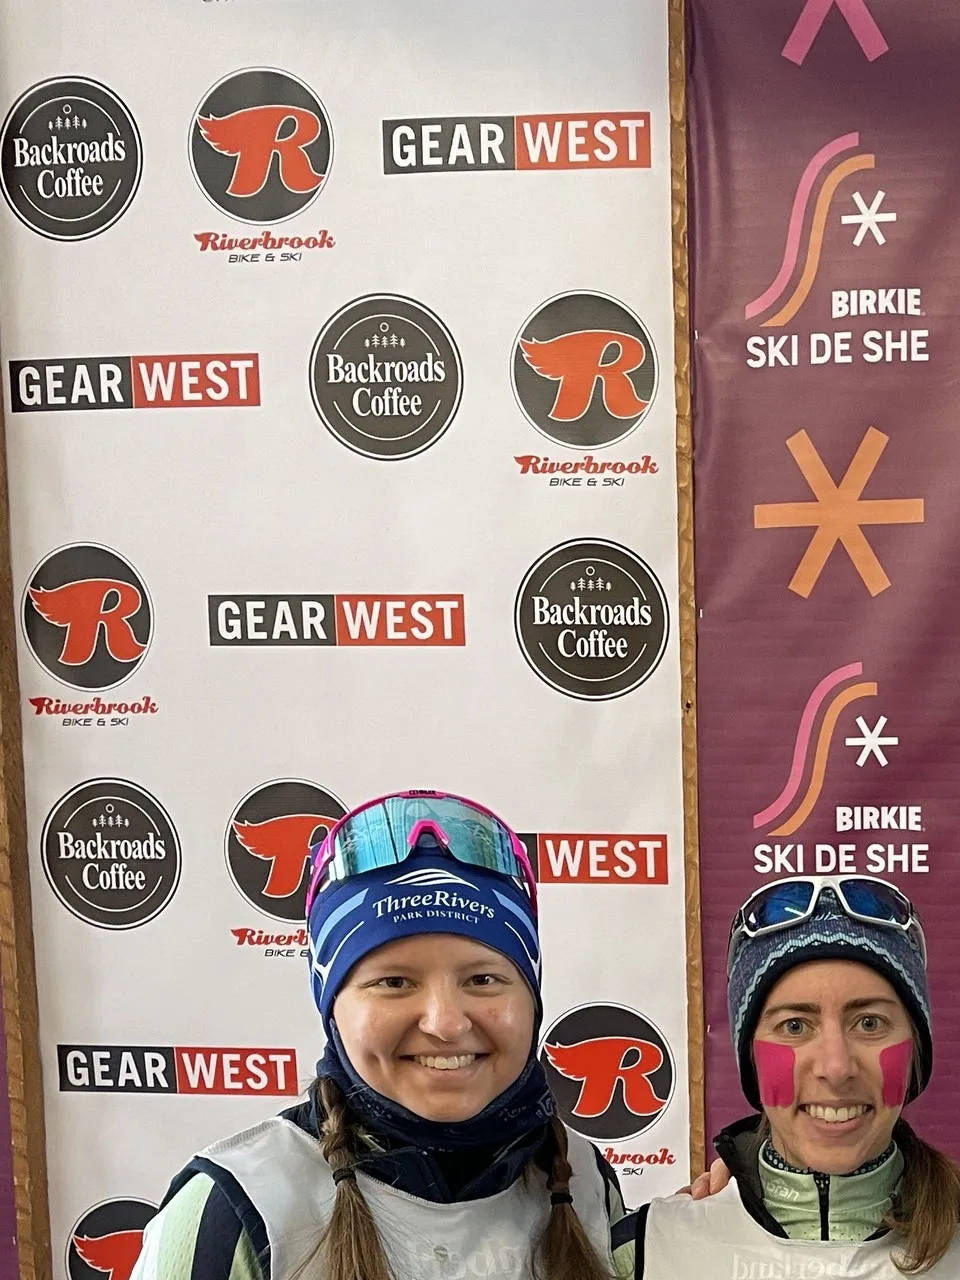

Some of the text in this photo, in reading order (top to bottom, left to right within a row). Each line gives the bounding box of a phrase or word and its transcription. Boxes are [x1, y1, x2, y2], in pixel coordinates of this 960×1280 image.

[13, 133, 127, 168] Backroads
[392, 118, 645, 167] GEAR WEST
[37, 167, 103, 199] Coffee
[194, 230, 336, 251] Riverbrook
[228, 252, 303, 263] BIKE & SKI
[832, 288, 921, 319] BIRKIE
[745, 330, 929, 368] SKI DE SHE
[18, 358, 256, 406] GEAR WEST
[326, 353, 446, 384] Backroads
[352, 387, 422, 418] Coffee
[514, 454, 659, 474] Riverbrook
[549, 477, 625, 487] BIKE & SKI
[217, 601, 459, 640] GEAR WEST
[533, 596, 653, 627] Backroads
[558, 630, 628, 659] Coffee
[28, 696, 159, 716] Riverbrook
[62, 718, 130, 726] BIKE & SKI
[836, 806, 921, 832] BIRKIE
[58, 832, 166, 860] Backroads
[547, 840, 662, 877] WEST
[754, 843, 929, 873] SKI DE SHE
[82, 862, 146, 891] Coffee
[372, 890, 495, 919] ThreeRivers
[393, 910, 480, 924] PARK DISTRICT
[230, 927, 309, 946] Riverb
[264, 949, 296, 957] BIKE
[66, 1051, 291, 1090] GEAR WEST
[622, 1167, 643, 1175] SKI
